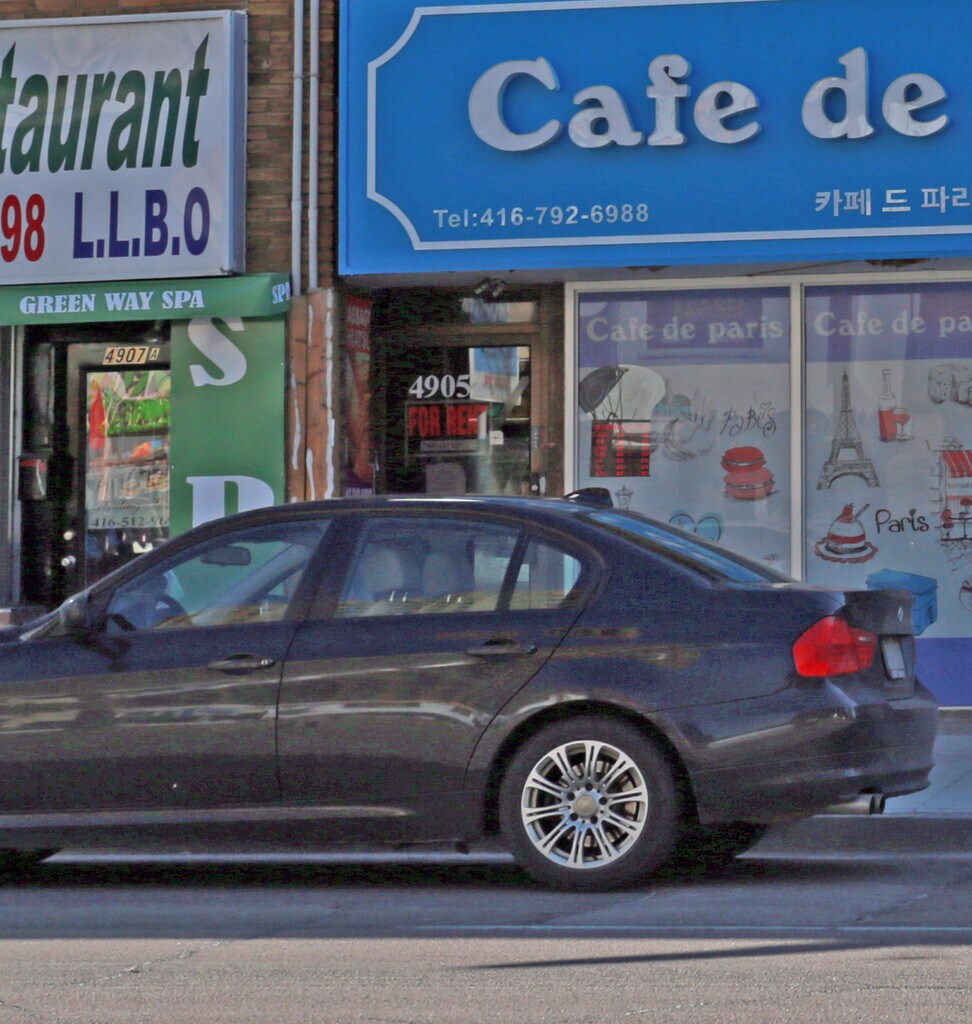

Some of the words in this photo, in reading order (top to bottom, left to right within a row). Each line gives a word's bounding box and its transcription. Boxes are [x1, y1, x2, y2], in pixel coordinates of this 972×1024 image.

[468, 53, 761, 152] Cafe
[801, 46, 948, 139] de
[434, 203, 650, 228] Tel:416-792-6988
[815, 188, 872, 217] 카페
[881, 190, 911, 212] 드
[0, 193, 45, 263] 98
[73, 187, 210, 259] L.L.B.O
[19, 294, 96, 315] GREEN
[104, 292, 154, 311] WAY
[162, 289, 205, 309] SPA
[586, 316, 653, 342] Cafe
[662, 316, 696, 340] de
[708, 316, 784, 344] paris
[814, 311, 882, 336] Cafe
[891, 310, 925, 334] de
[104, 347, 147, 364] 4907
[149, 348, 160, 360] A
[409, 374, 471, 399] 4905
[408, 406, 441, 438] FOR
[875, 507, 930, 534] Paris
